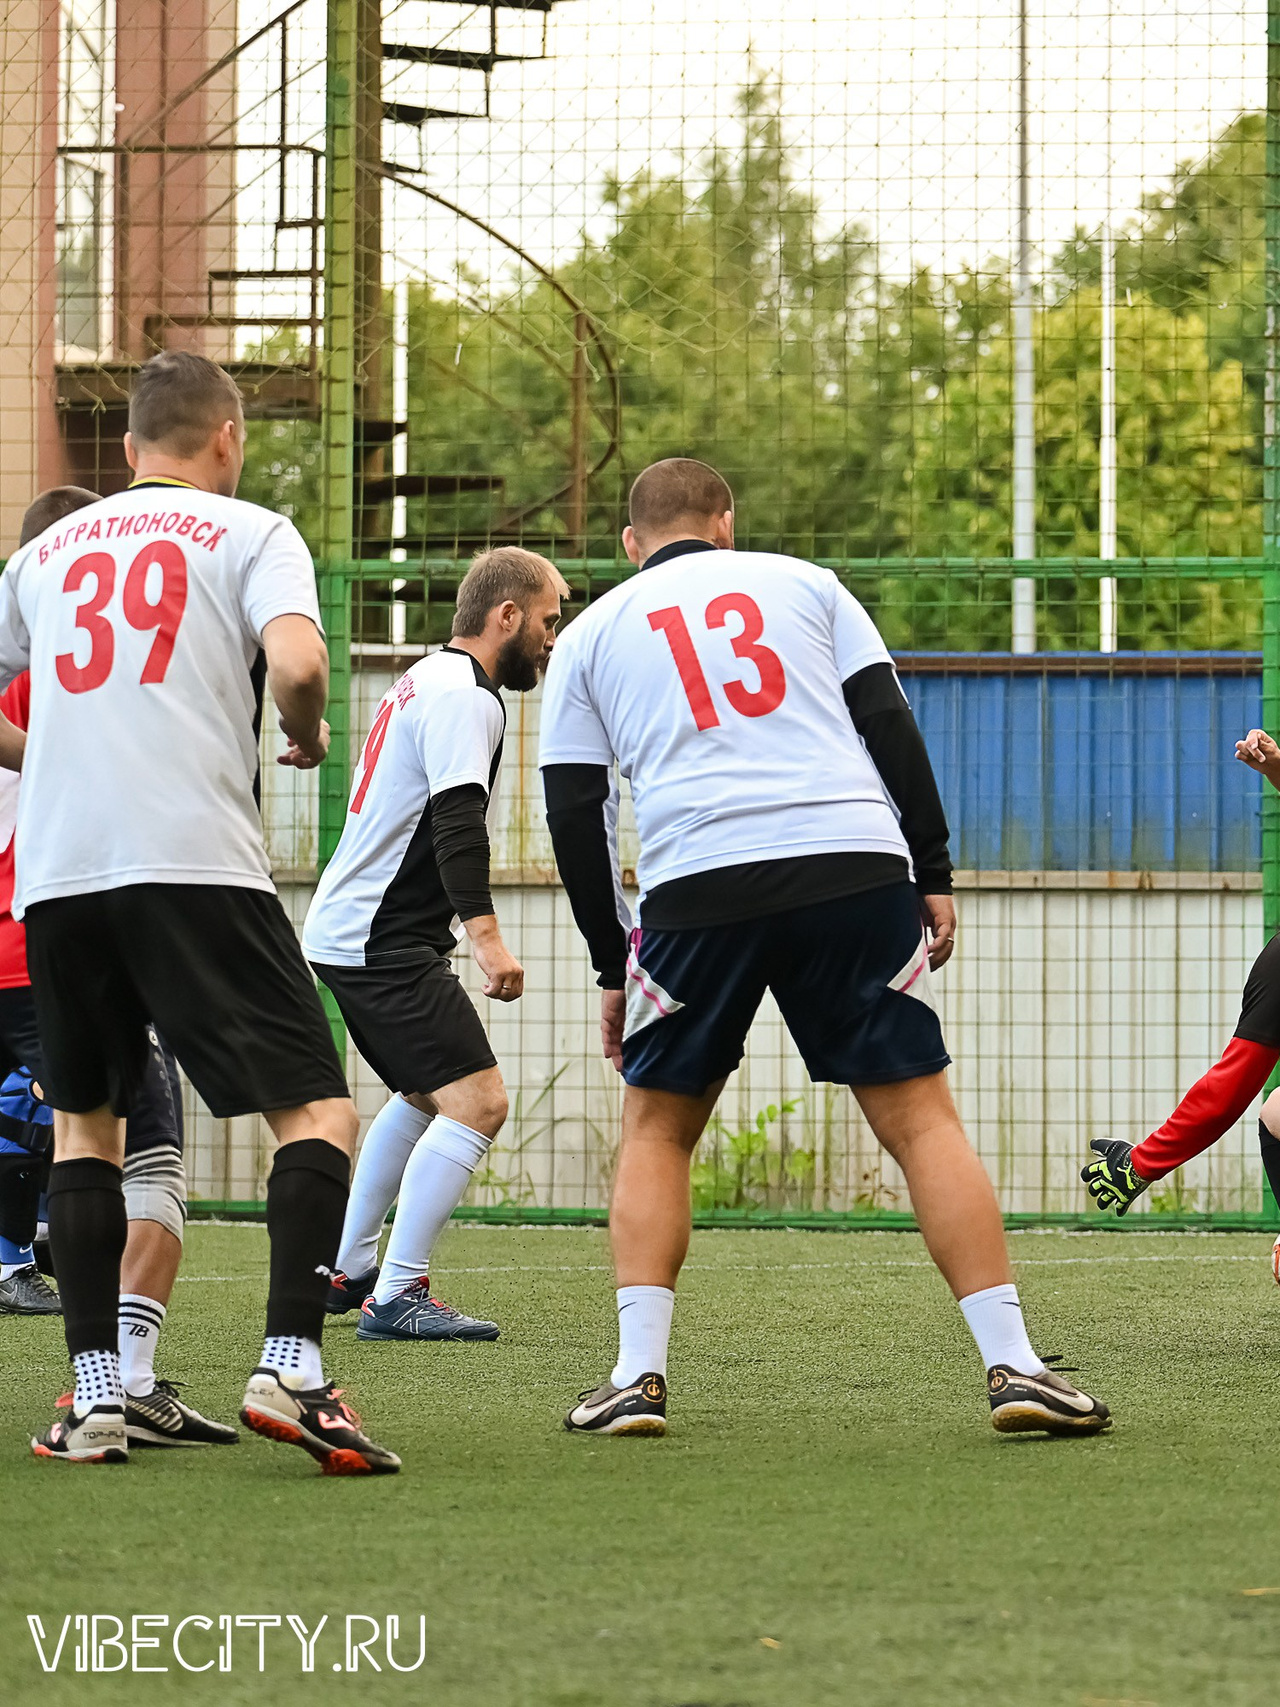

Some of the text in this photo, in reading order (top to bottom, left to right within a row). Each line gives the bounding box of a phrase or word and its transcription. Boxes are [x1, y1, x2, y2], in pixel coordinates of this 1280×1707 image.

[38, 511, 228, 567] БАГРАТИОНОВСК
[55, 539, 188, 695] 39
[646, 592, 787, 732] 13
[349, 698, 395, 815] 9
